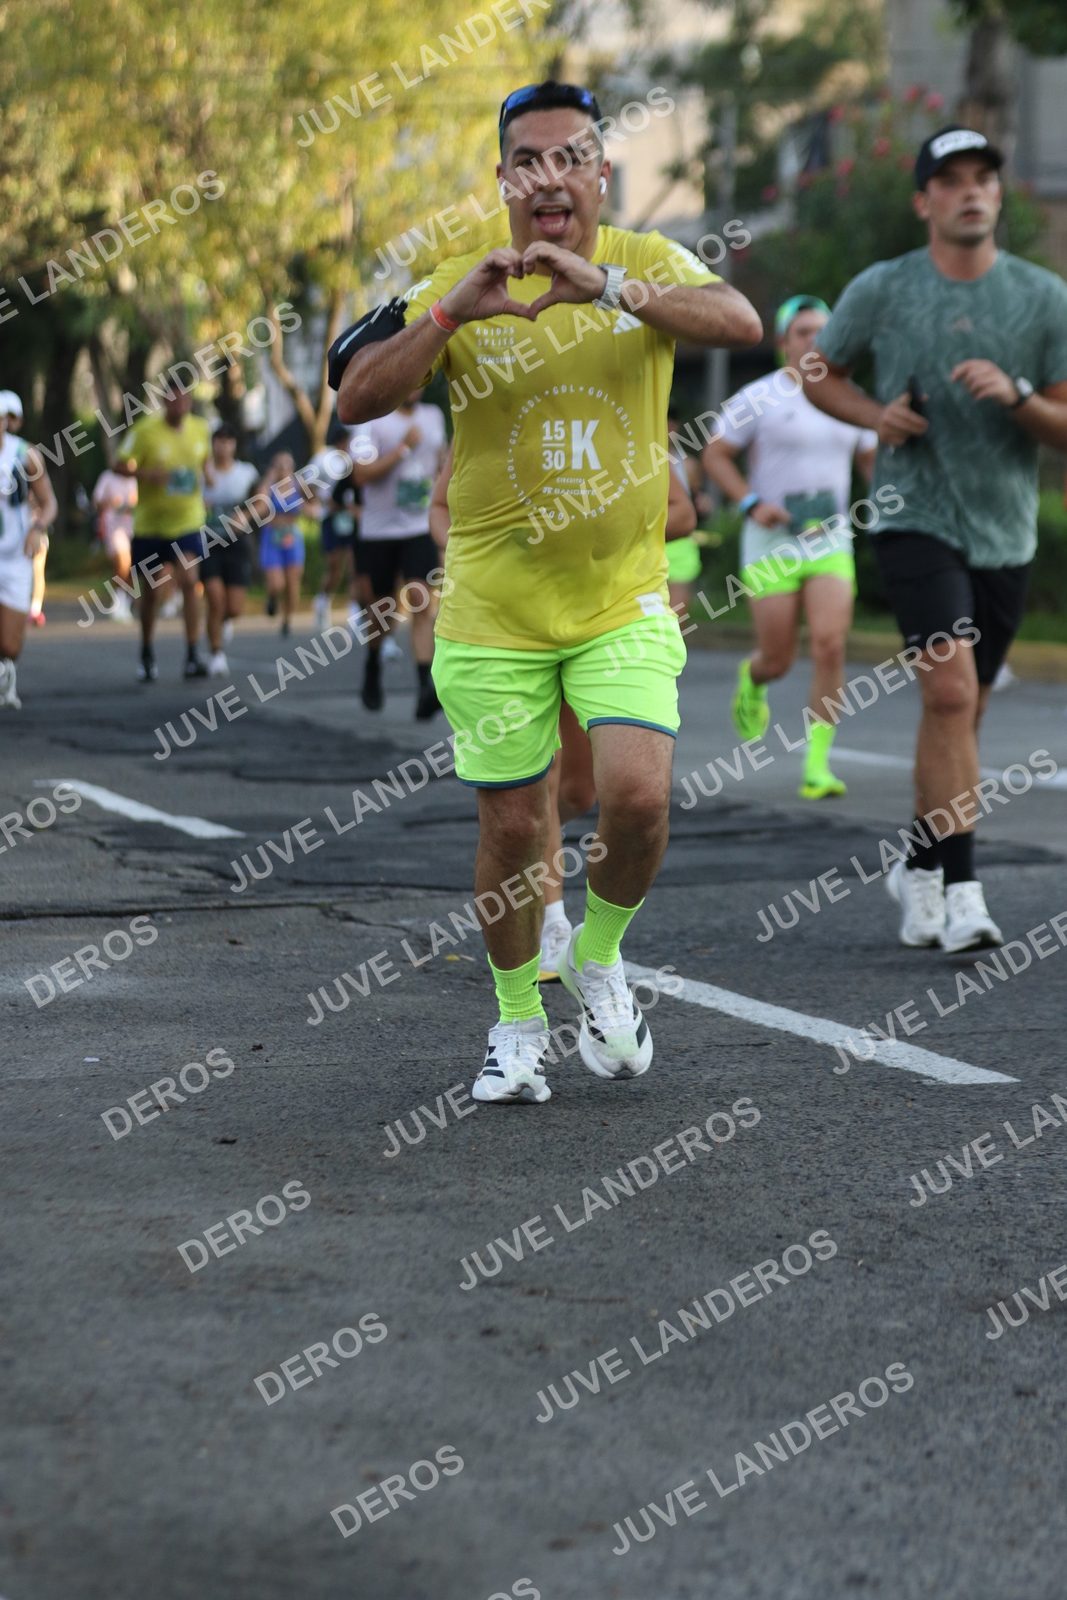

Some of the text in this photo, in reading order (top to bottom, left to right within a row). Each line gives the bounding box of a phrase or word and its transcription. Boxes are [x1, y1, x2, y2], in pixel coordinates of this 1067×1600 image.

[542, 419, 565, 441] 15
[571, 419, 602, 470] K
[542, 449, 566, 471] 30
